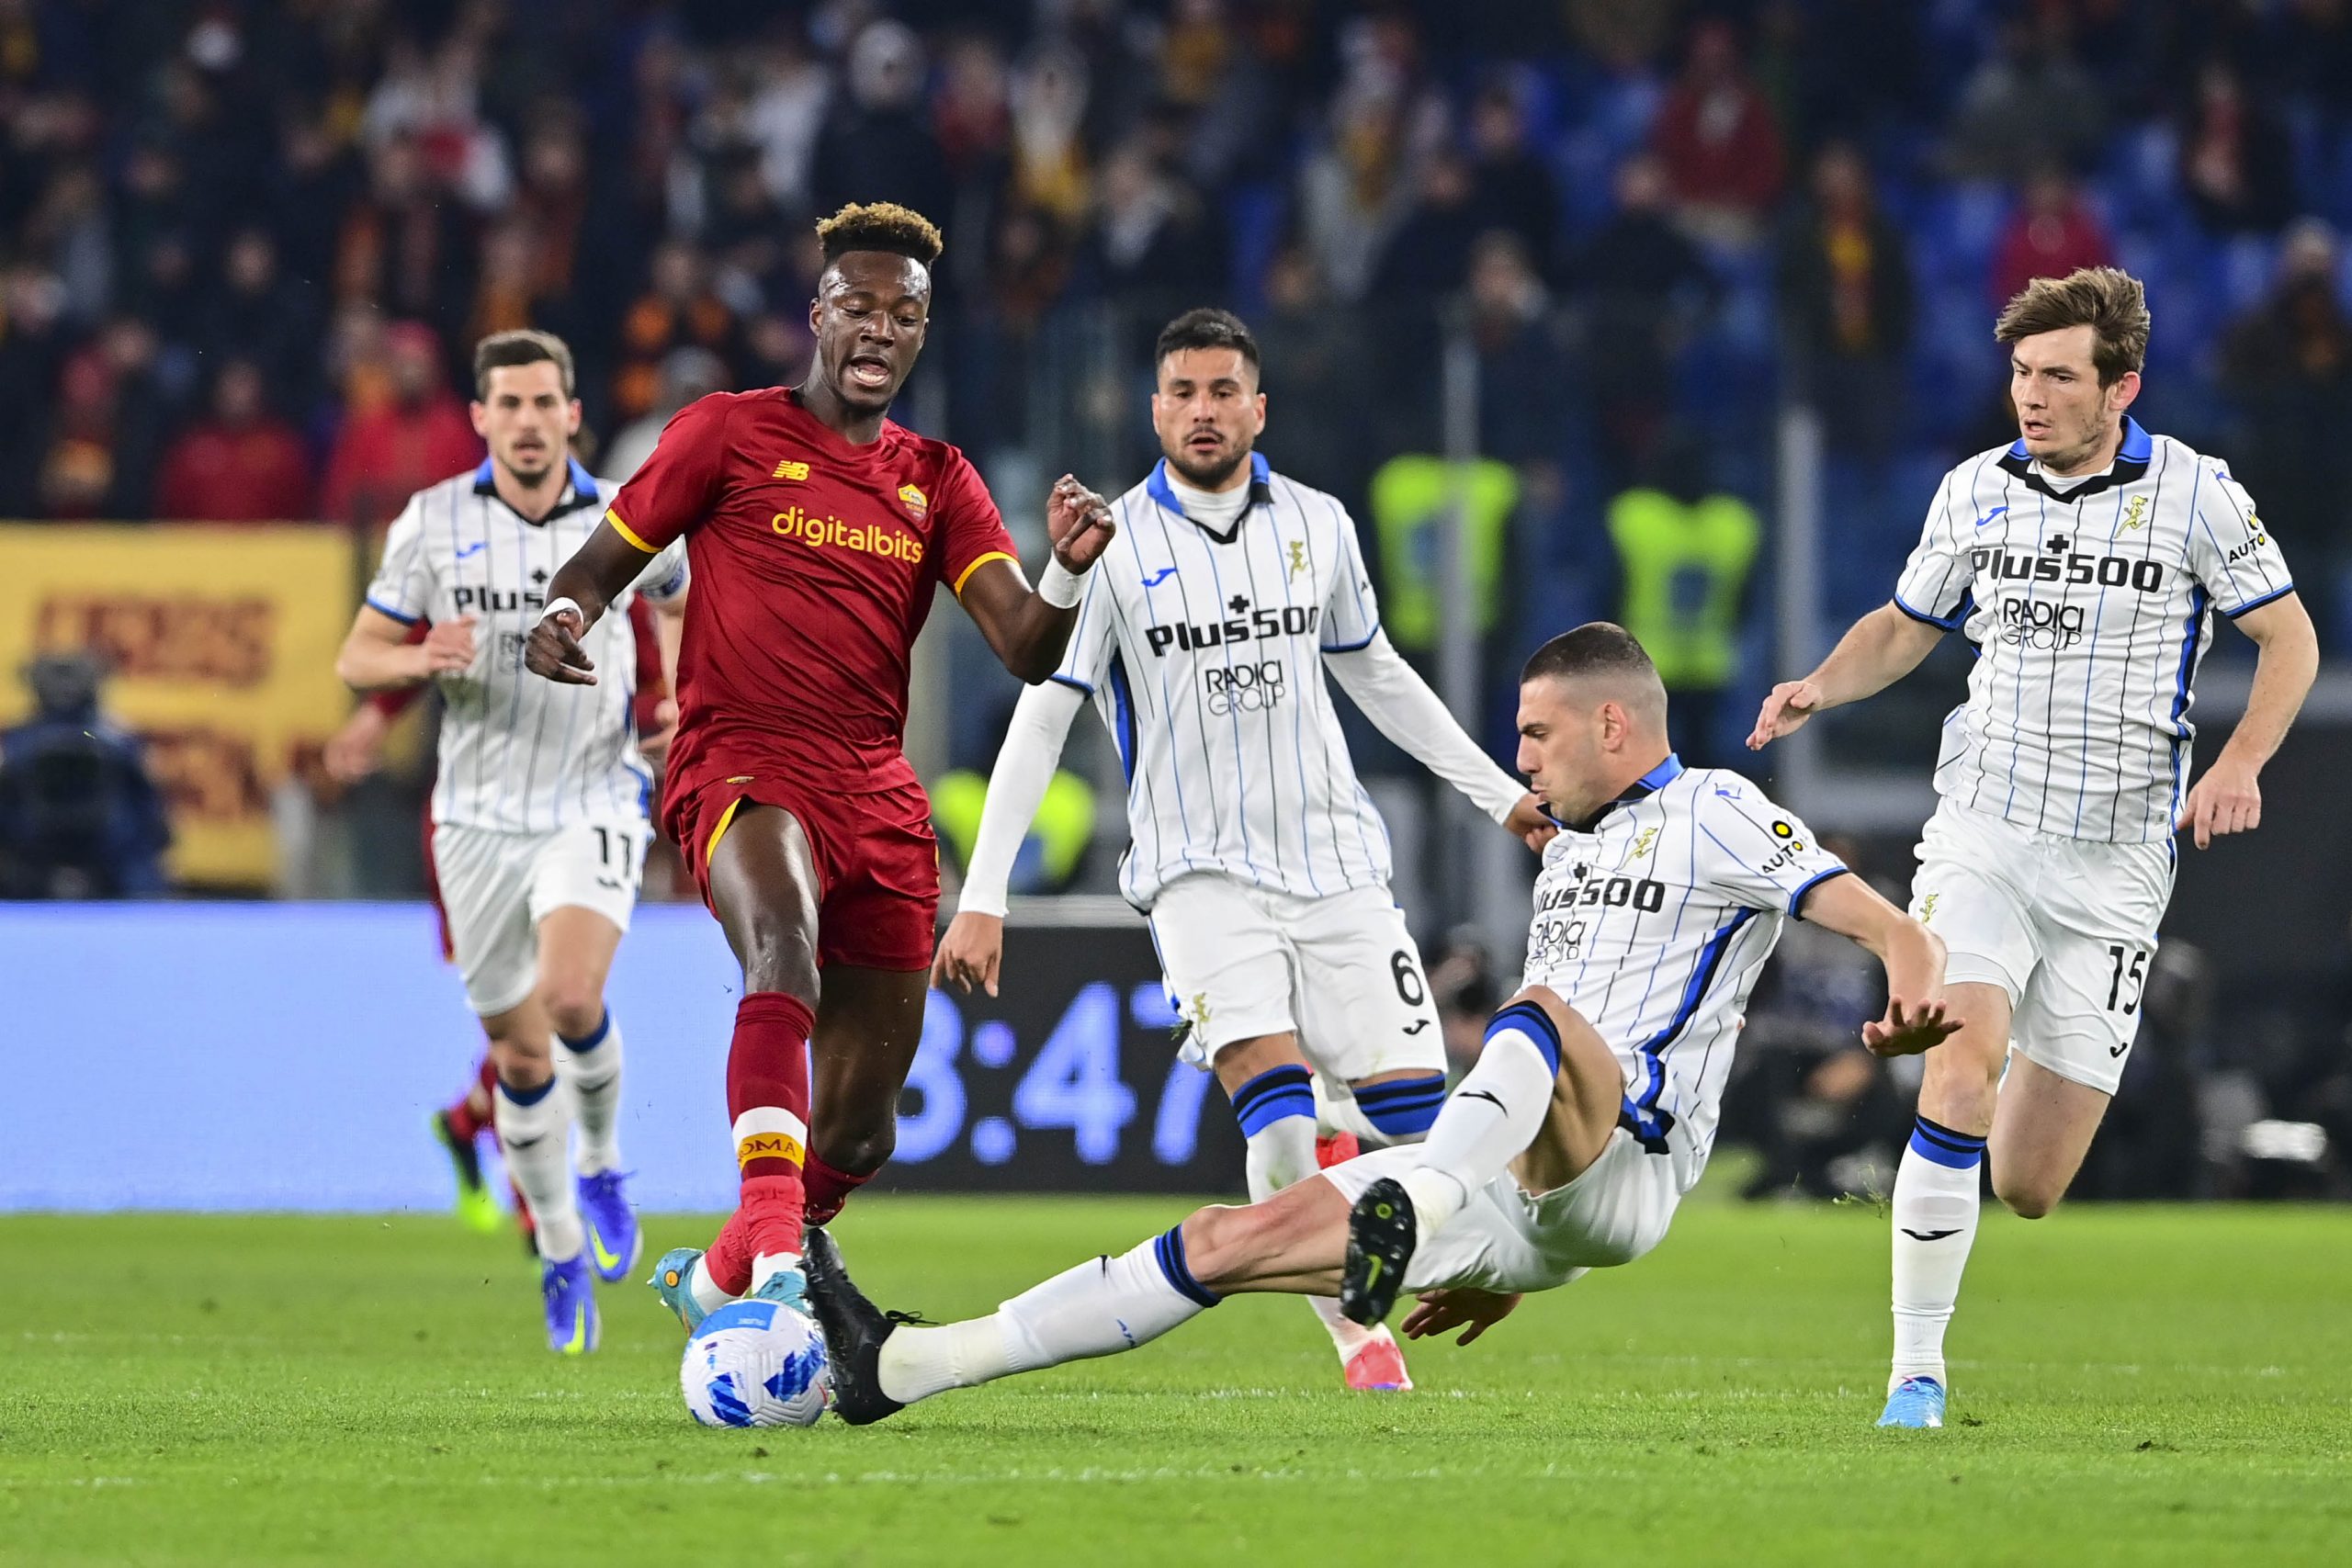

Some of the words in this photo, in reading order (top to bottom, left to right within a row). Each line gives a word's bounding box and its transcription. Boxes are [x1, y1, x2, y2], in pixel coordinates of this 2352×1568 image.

[772, 506, 923, 564] digitalbits
[1971, 548, 2164, 593] Plus500
[454, 587, 546, 615] Plus
[2003, 597, 2085, 633] RADICI
[2000, 624, 2082, 651] GROUP
[1204, 660, 1284, 694] RADICI
[1208, 683, 1286, 716] GROUP
[591, 825, 631, 879] 11
[1390, 950, 1424, 1007] 6
[2107, 945, 2146, 1015] 15
